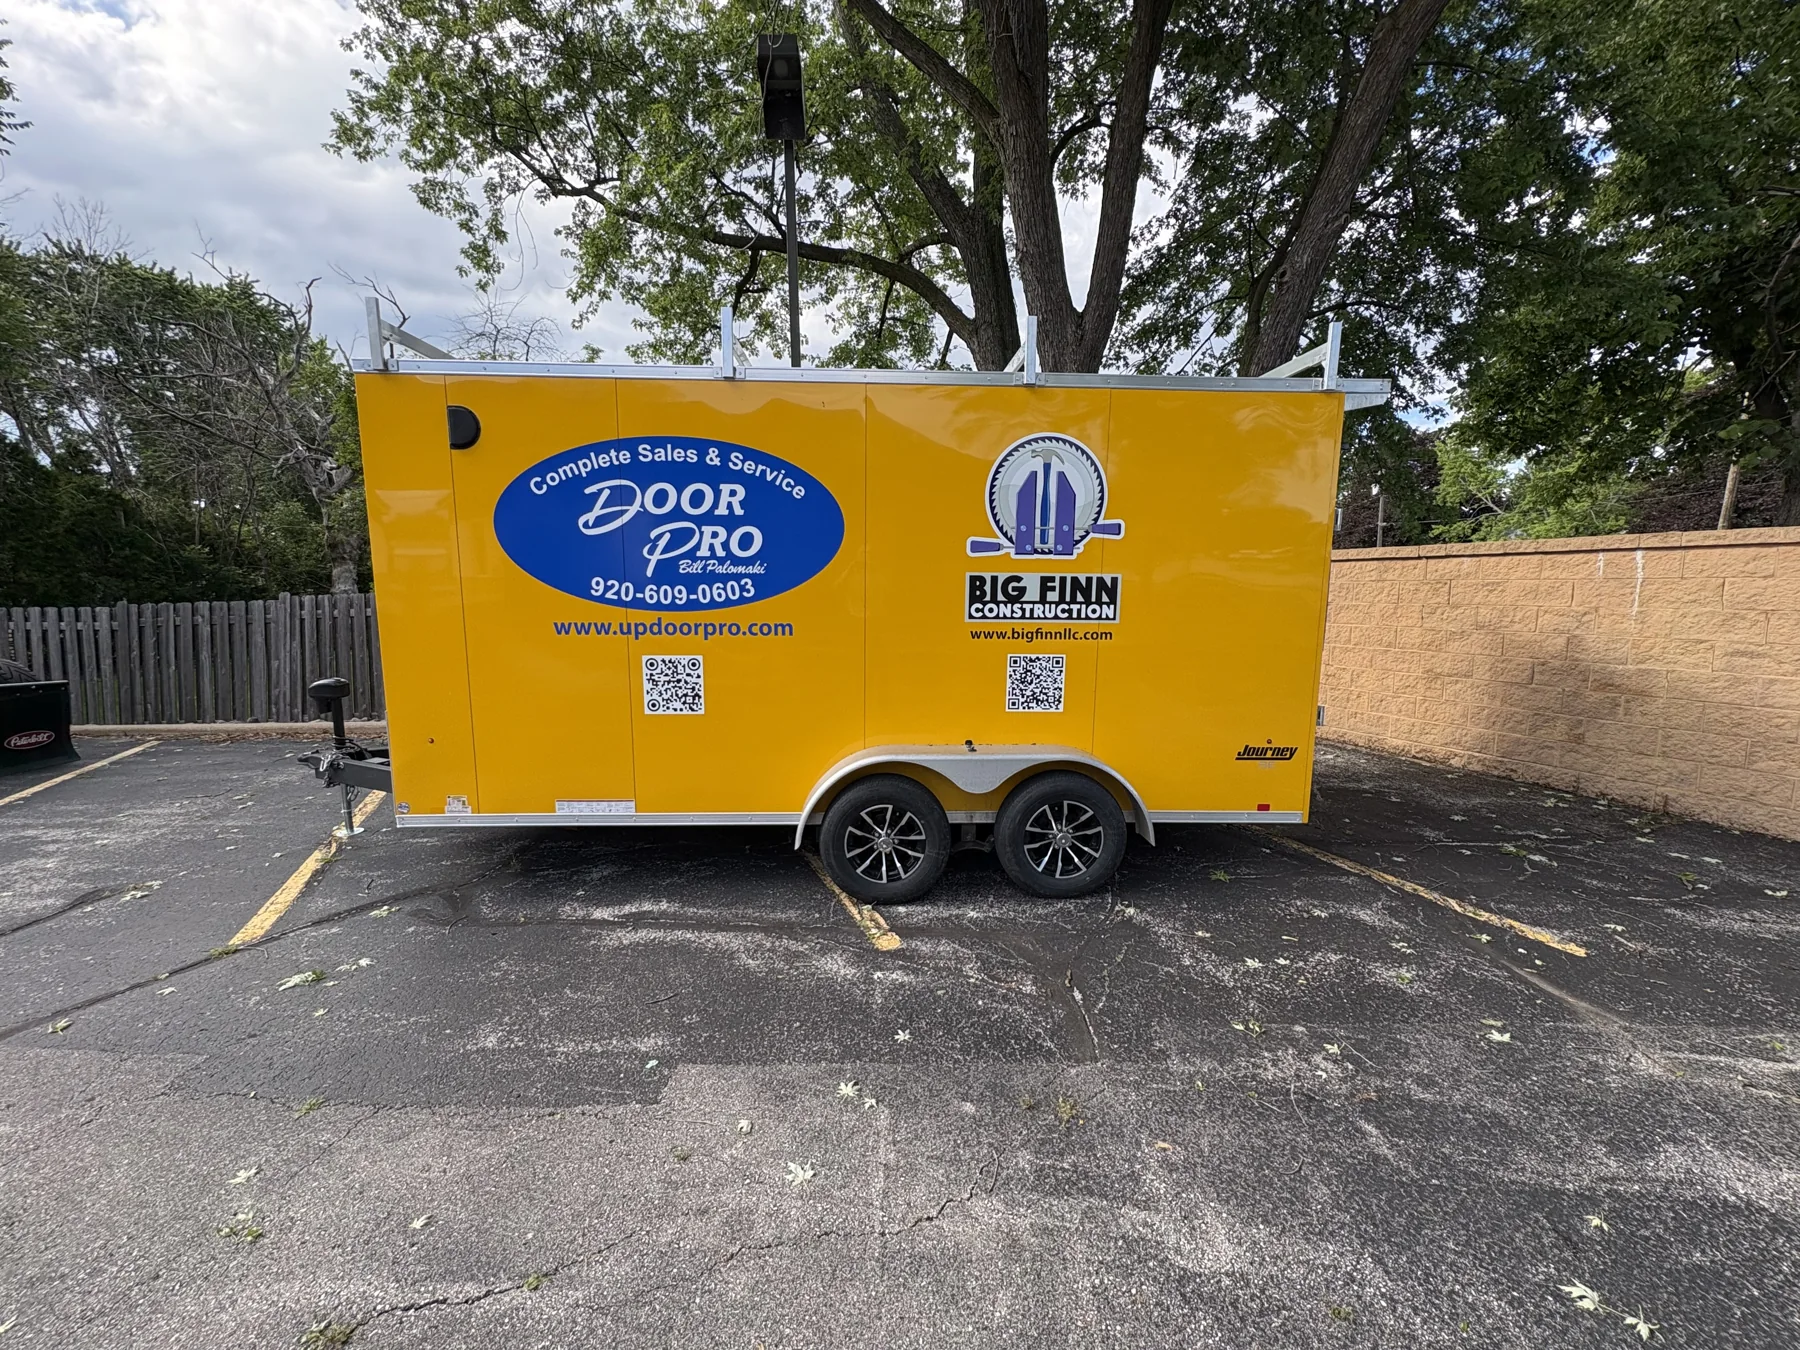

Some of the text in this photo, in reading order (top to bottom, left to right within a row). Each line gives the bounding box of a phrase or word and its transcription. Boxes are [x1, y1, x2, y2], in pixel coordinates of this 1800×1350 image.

[529, 444, 806, 499] Complete Sales & Service
[577, 479, 746, 536] DOOR
[642, 521, 763, 578] PRO
[678, 559, 767, 575] Bill Palomaki
[590, 576, 756, 605] 920-609-0603
[969, 574, 1119, 603] BIG FINN
[970, 603, 1115, 619] CONSTRUCTION
[553, 617, 794, 640] www.updoorpro.com
[970, 627, 1113, 643] www.bigfinnllc.com
[1237, 744, 1298, 757] Journey
